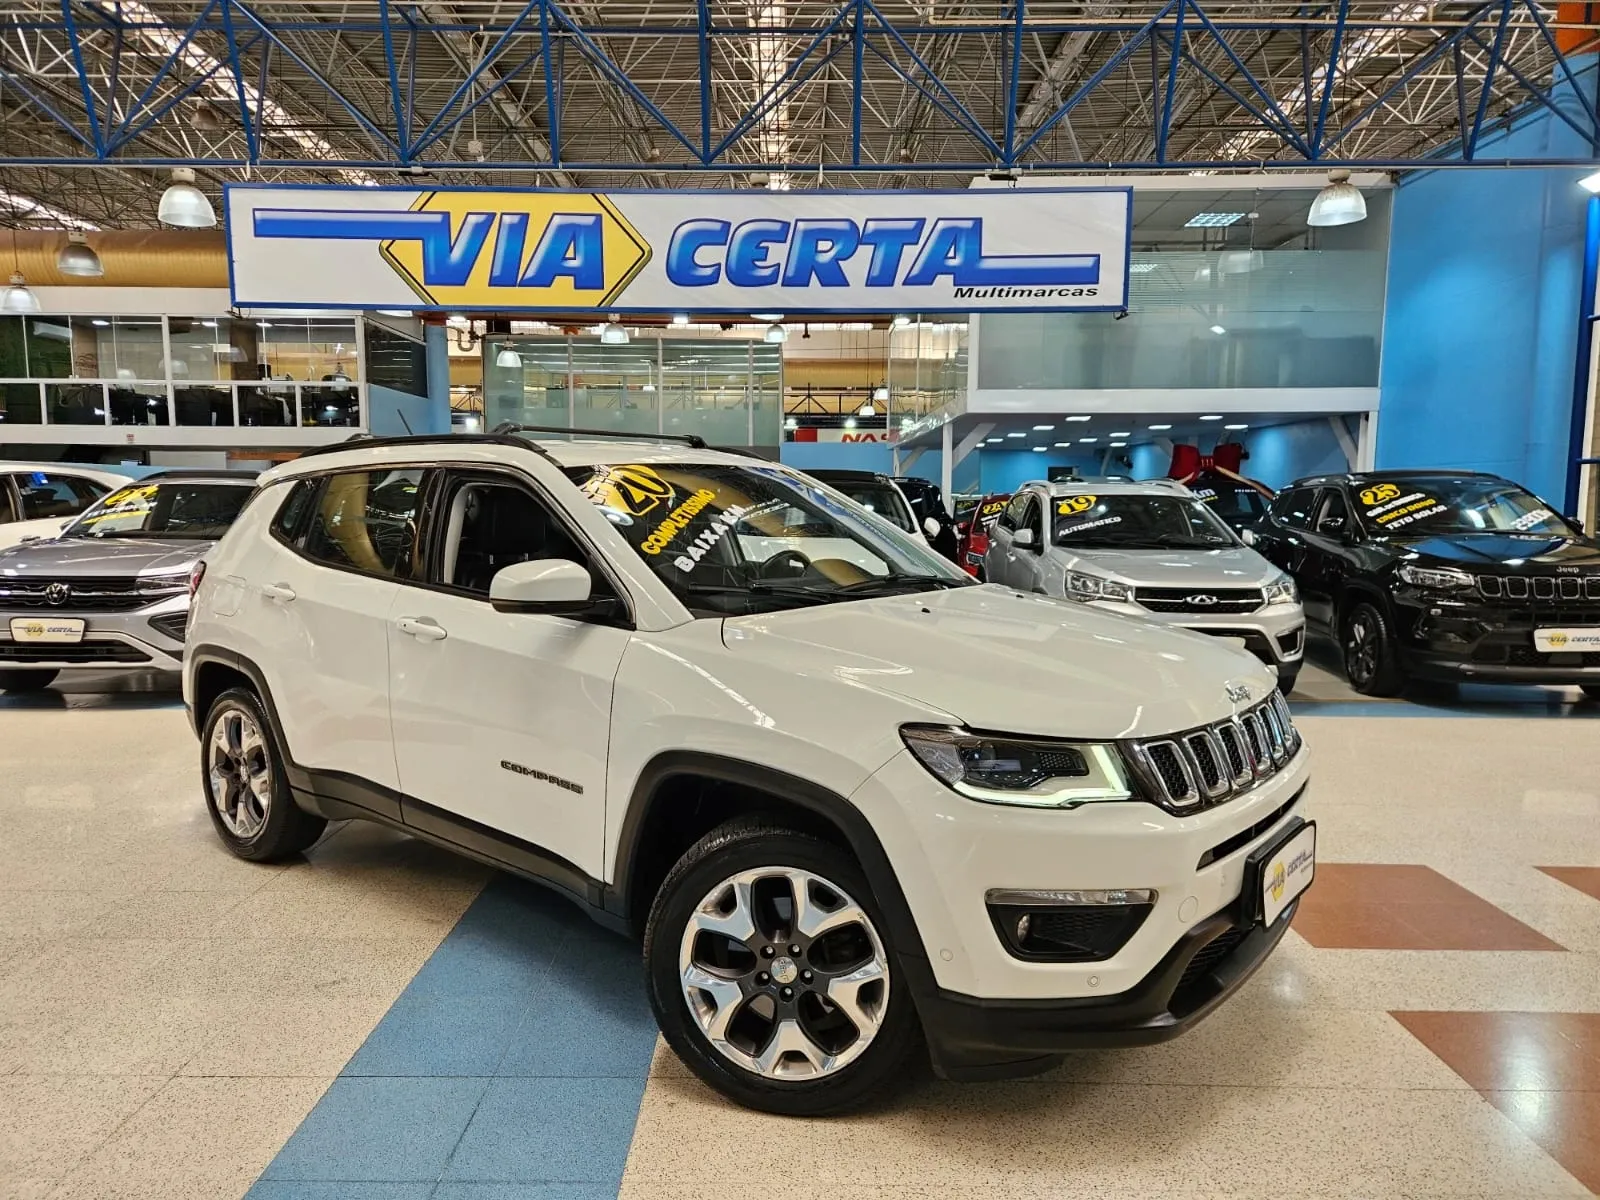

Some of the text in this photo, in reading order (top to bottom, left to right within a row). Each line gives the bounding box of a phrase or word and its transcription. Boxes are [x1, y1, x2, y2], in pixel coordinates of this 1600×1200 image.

[412, 209, 984, 290] VIA CERTA
[953, 286, 1099, 299] Multimarcas
[1360, 484, 1400, 505] 25
[641, 488, 716, 555] COMPLETISSIMO
[1385, 515, 1414, 530] TETO
[1412, 505, 1447, 520] SOLAR
[500, 760, 584, 795] COMPASS
